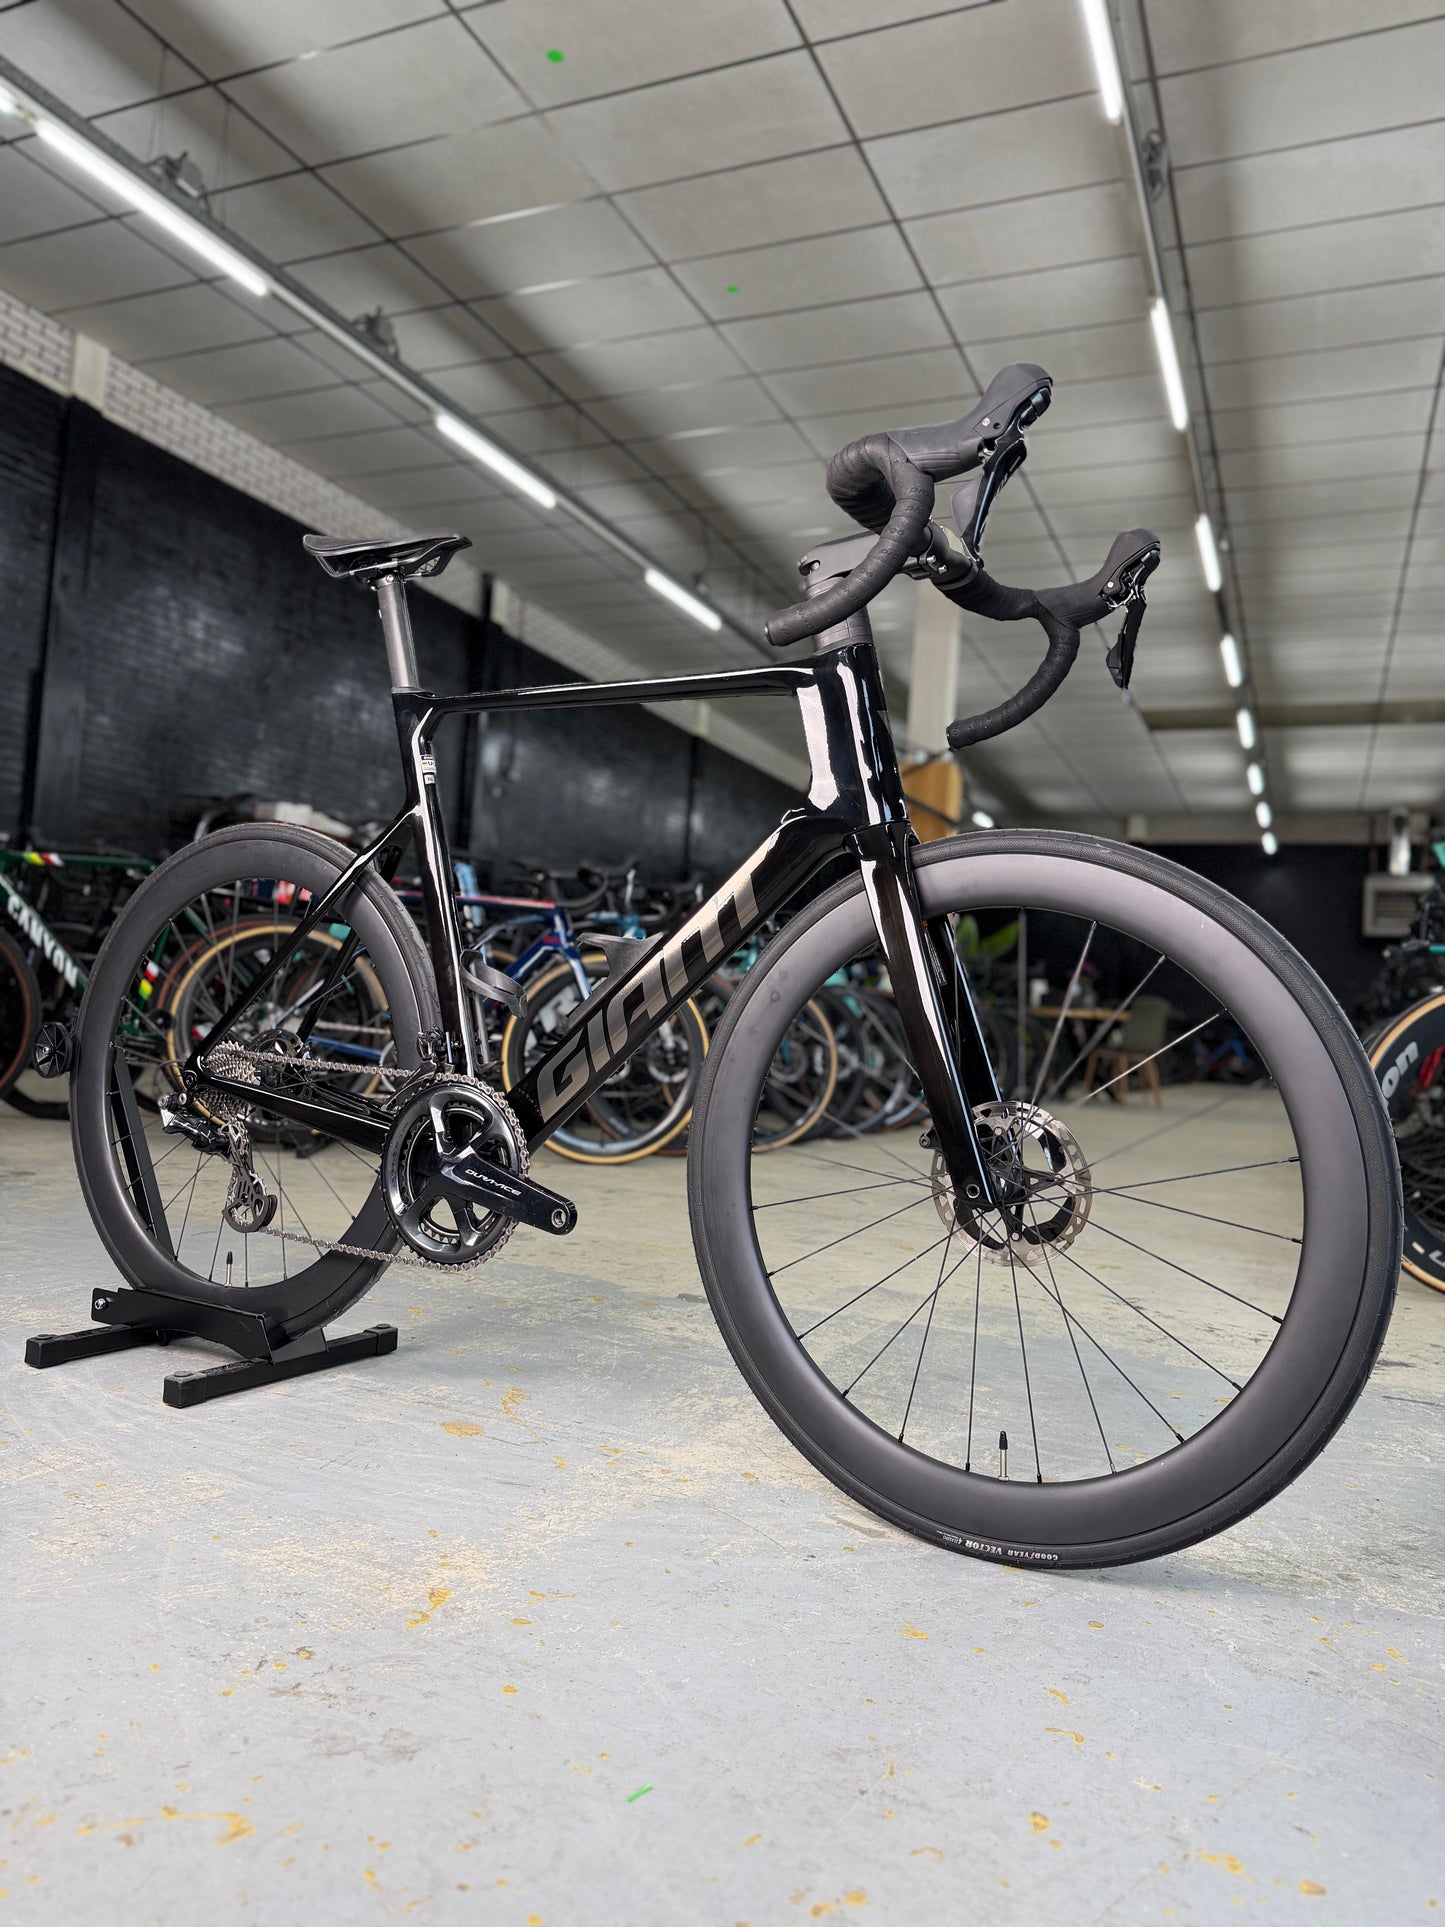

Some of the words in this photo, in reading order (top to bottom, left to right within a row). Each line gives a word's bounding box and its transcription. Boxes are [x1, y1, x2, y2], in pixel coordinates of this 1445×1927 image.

[7, 894, 78, 988] CANYON
[537, 832, 780, 1123] GIANT
[965, 1539, 1002, 1555] VECTOR
[1007, 1549, 1059, 1561] GOODYEAR
